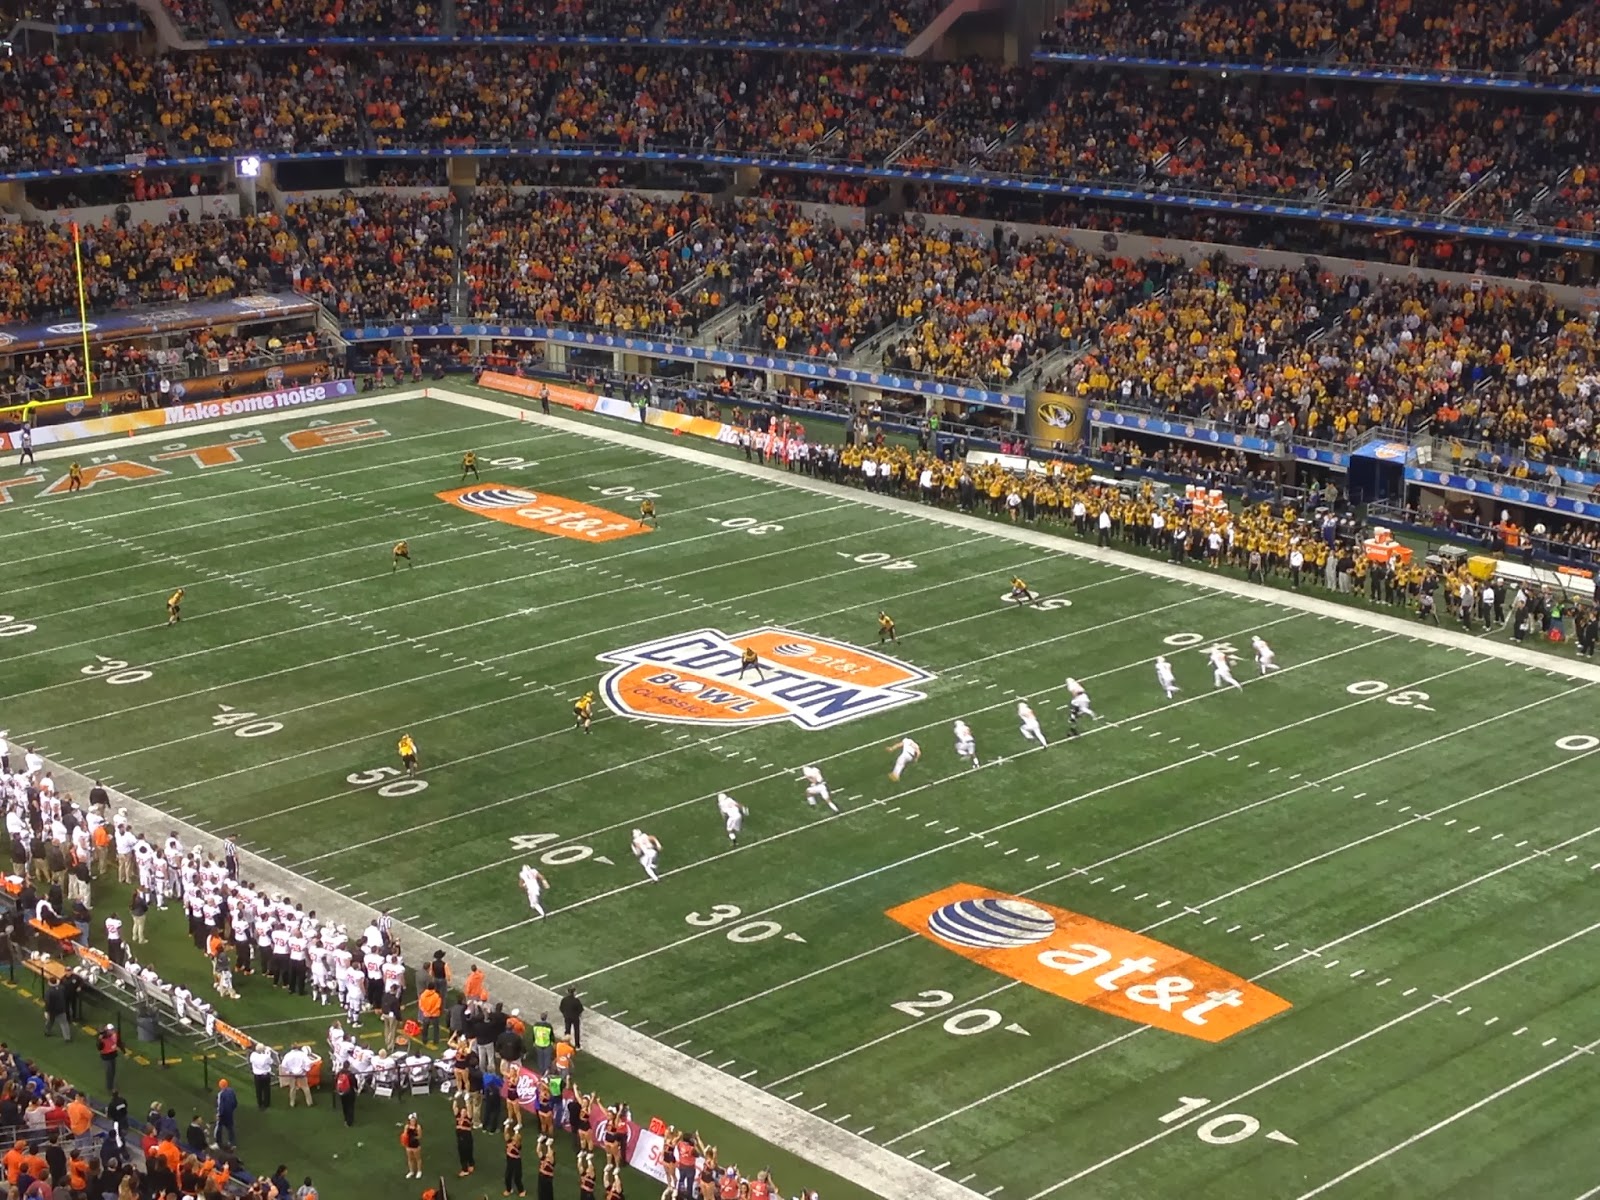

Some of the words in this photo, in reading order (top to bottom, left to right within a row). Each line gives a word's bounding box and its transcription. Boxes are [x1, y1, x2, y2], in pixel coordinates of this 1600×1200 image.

[165, 402, 220, 425] Make
[222, 393, 275, 417] some
[275, 386, 326, 408] noise
[515, 502, 629, 538] at&t
[721, 517, 784, 535] 30
[853, 552, 918, 570] 40
[80, 660, 153, 685] 30
[634, 637, 891, 718] COTTON
[807, 655, 871, 676] at&t
[632, 687, 704, 714] CLASSIC
[645, 672, 758, 714] BOWL
[1346, 680, 1430, 705] 30
[212, 711, 285, 738] 40
[346, 766, 429, 797] 50
[508, 833, 594, 865] 40
[685, 904, 783, 943] 30
[1037, 943, 1244, 1026] at&t
[891, 989, 1002, 1036] 20
[1158, 1096, 1261, 1145] 10
